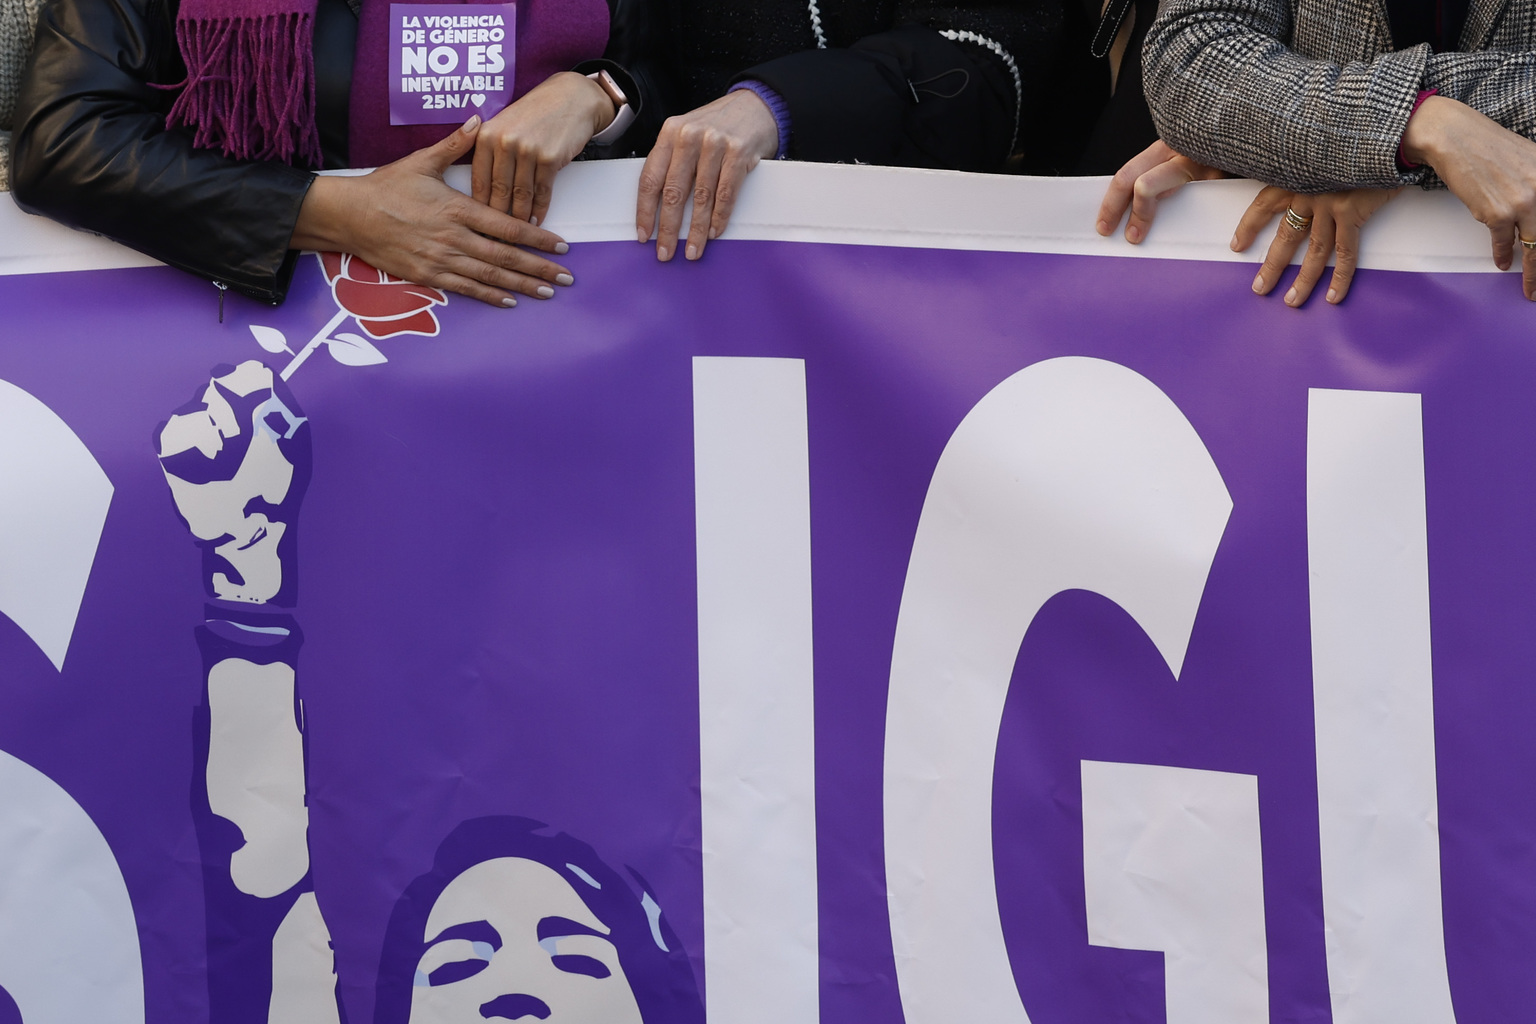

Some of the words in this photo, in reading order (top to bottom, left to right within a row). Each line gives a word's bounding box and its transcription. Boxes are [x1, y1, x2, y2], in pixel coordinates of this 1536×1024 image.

[402, 16, 421, 28] LA
[423, 15, 505, 28] VIOLENCIA
[402, 29, 426, 44] DE
[429, 27, 505, 44] GÉNERO
[401, 45, 459, 75] NO
[467, 44, 506, 74] ES
[401, 76, 504, 93] INEVITABLE
